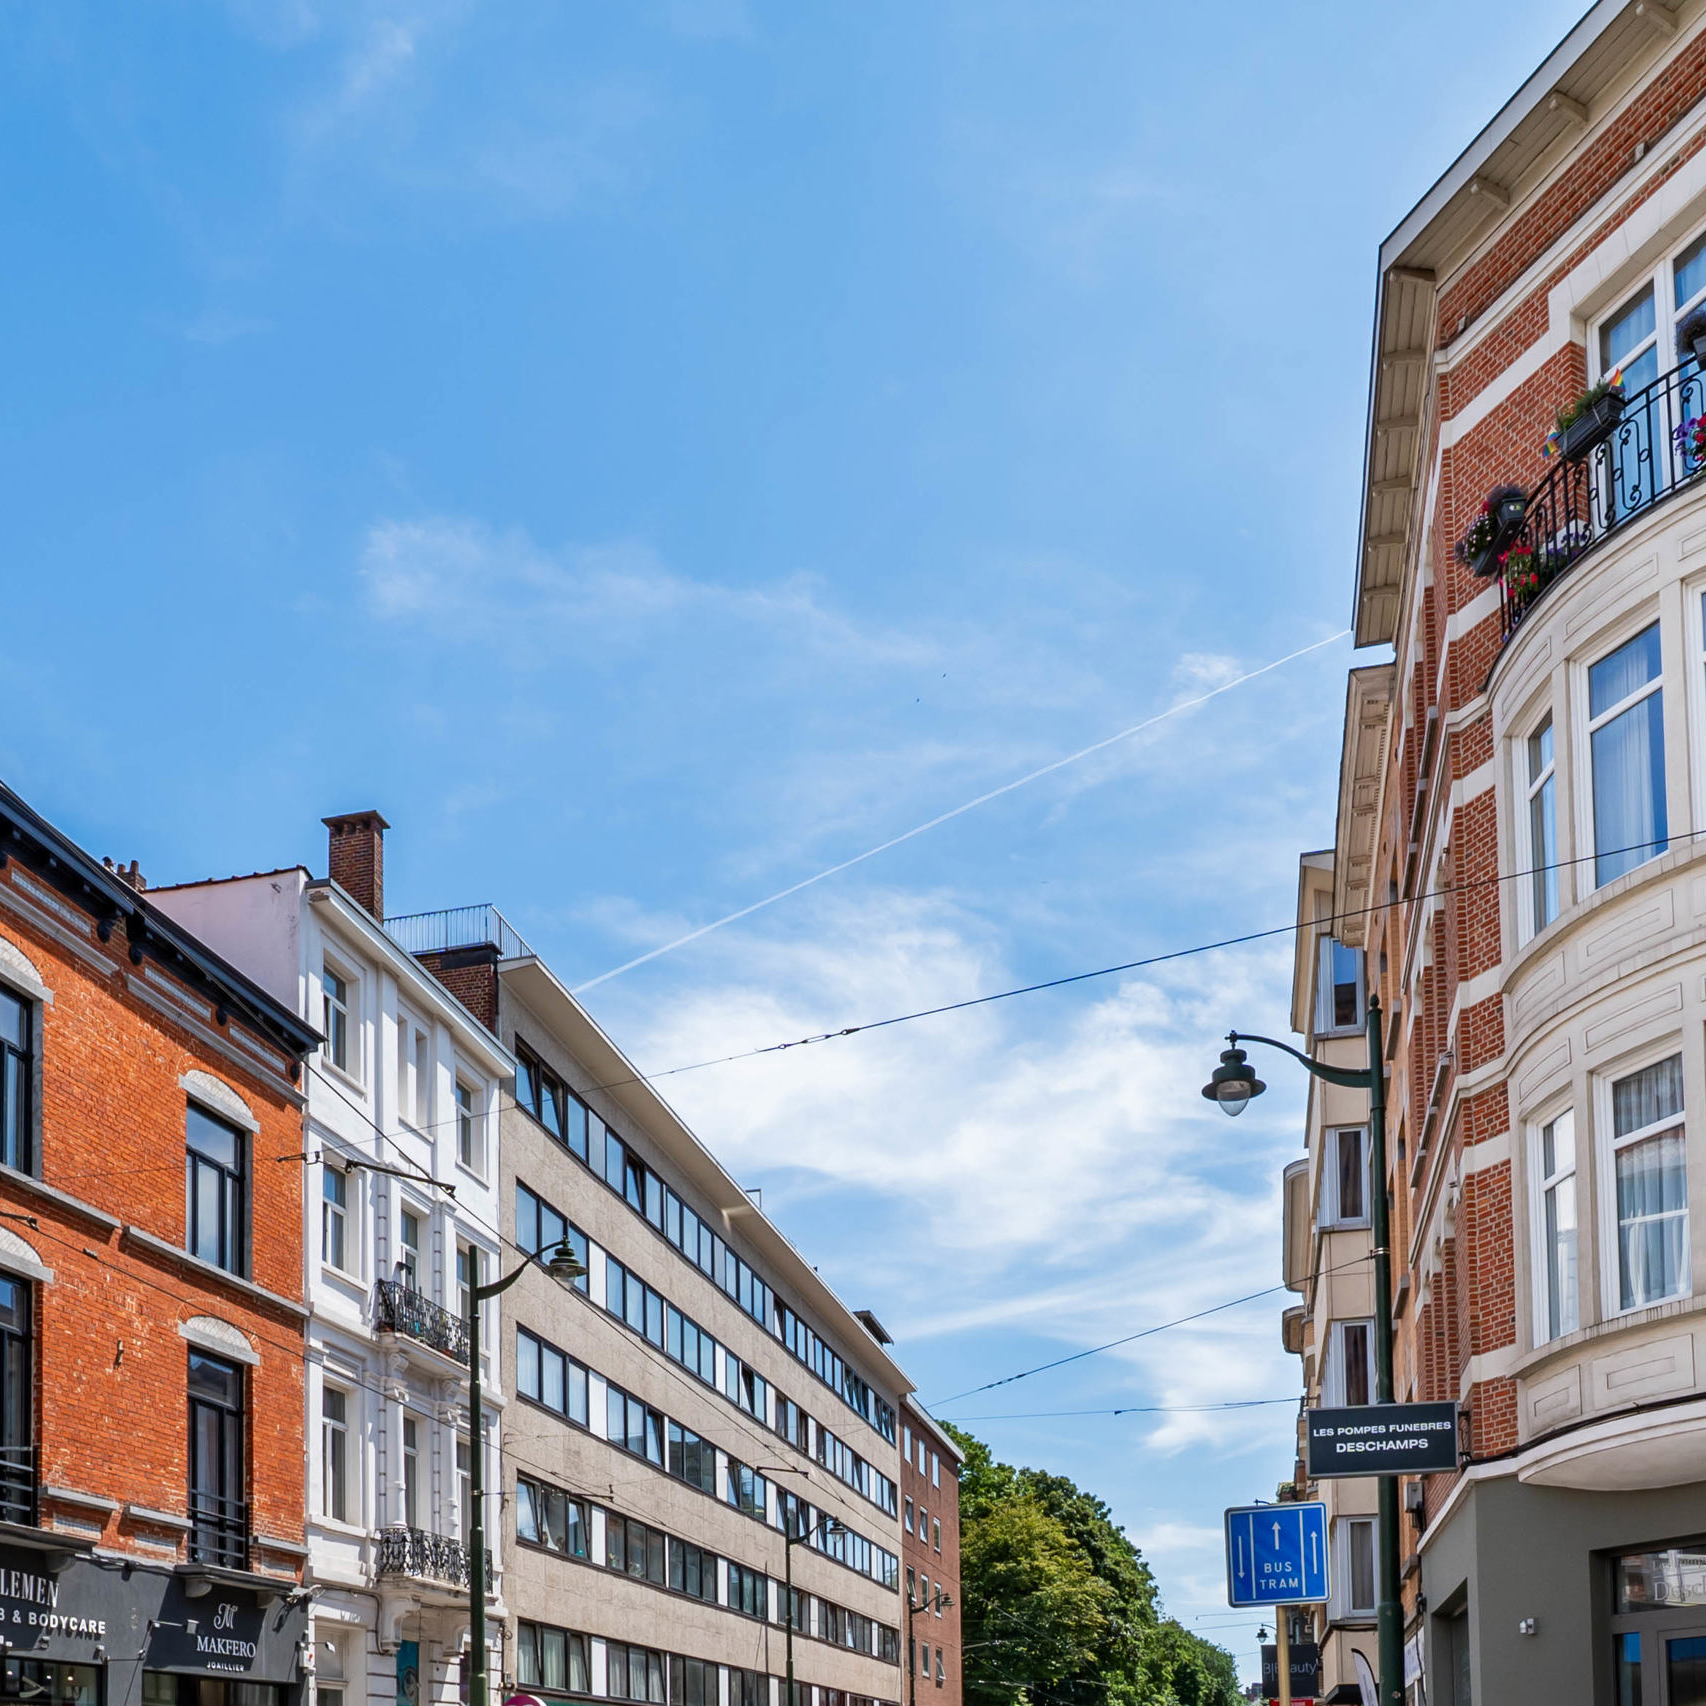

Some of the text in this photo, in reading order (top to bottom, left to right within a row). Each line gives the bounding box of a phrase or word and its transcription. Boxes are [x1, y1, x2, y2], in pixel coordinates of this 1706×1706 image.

[1313, 1421, 1451, 1437] LES POMPES FUNEBRES
[1336, 1438, 1429, 1453] DESCHAMPS
[1264, 1561, 1292, 1573] BUS
[1259, 1577, 1299, 1590] TRAM
[12, 1610, 22, 1624] &
[28, 1611, 106, 1635] BODYCARE
[197, 1635, 257, 1658] MAKFERO
[206, 1661, 245, 1672] JOAILLIER
